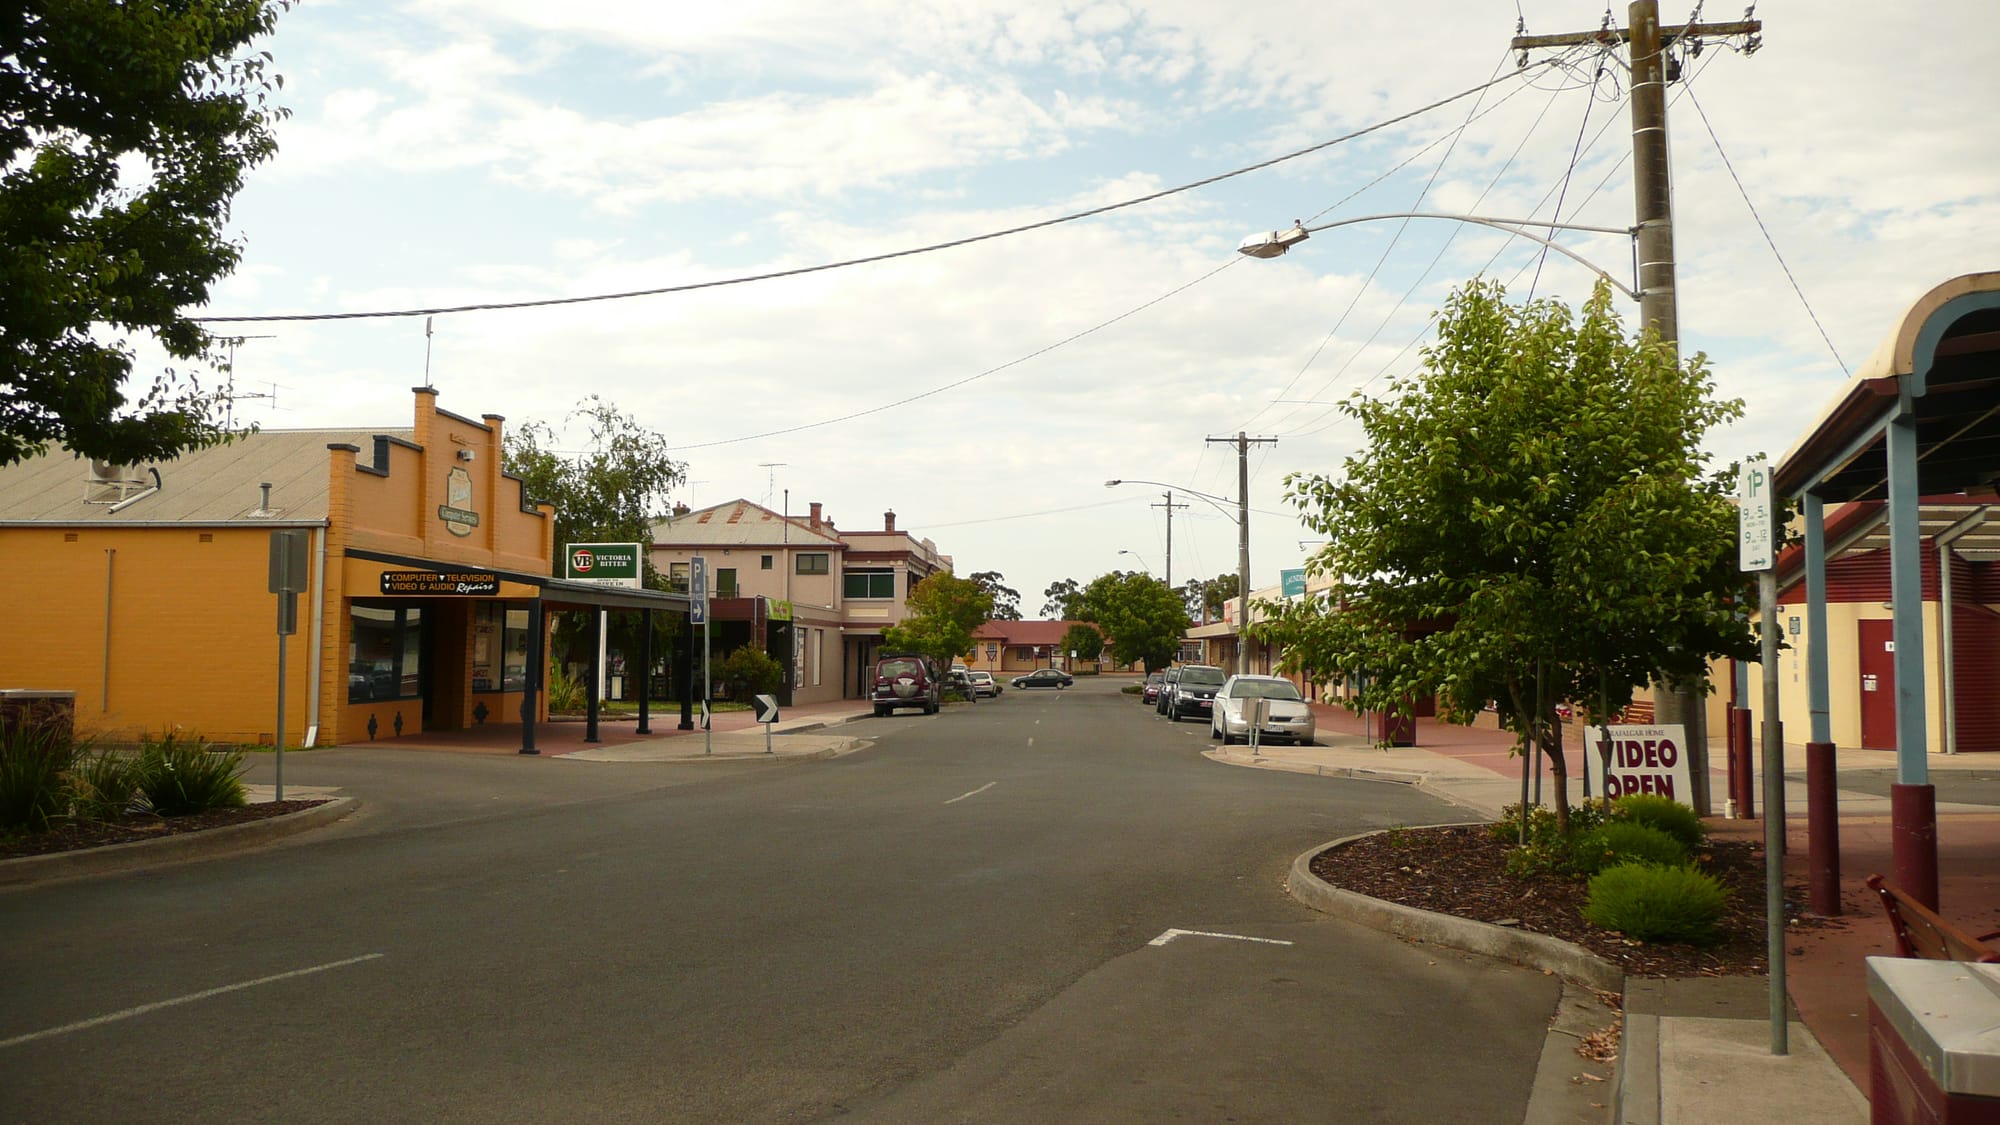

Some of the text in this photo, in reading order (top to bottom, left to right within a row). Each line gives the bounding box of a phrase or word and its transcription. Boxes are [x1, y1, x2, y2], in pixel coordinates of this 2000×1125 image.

[574, 556, 592, 566] VB
[694, 563, 701, 578] P
[391, 573, 494, 582] COMPUTER TELEVISION
[456, 582, 494, 593] Repairs
[1645, 729, 1665, 737] HOME
[1596, 739, 1677, 768] VIDEO
[1606, 774, 1675, 801] OPEN
